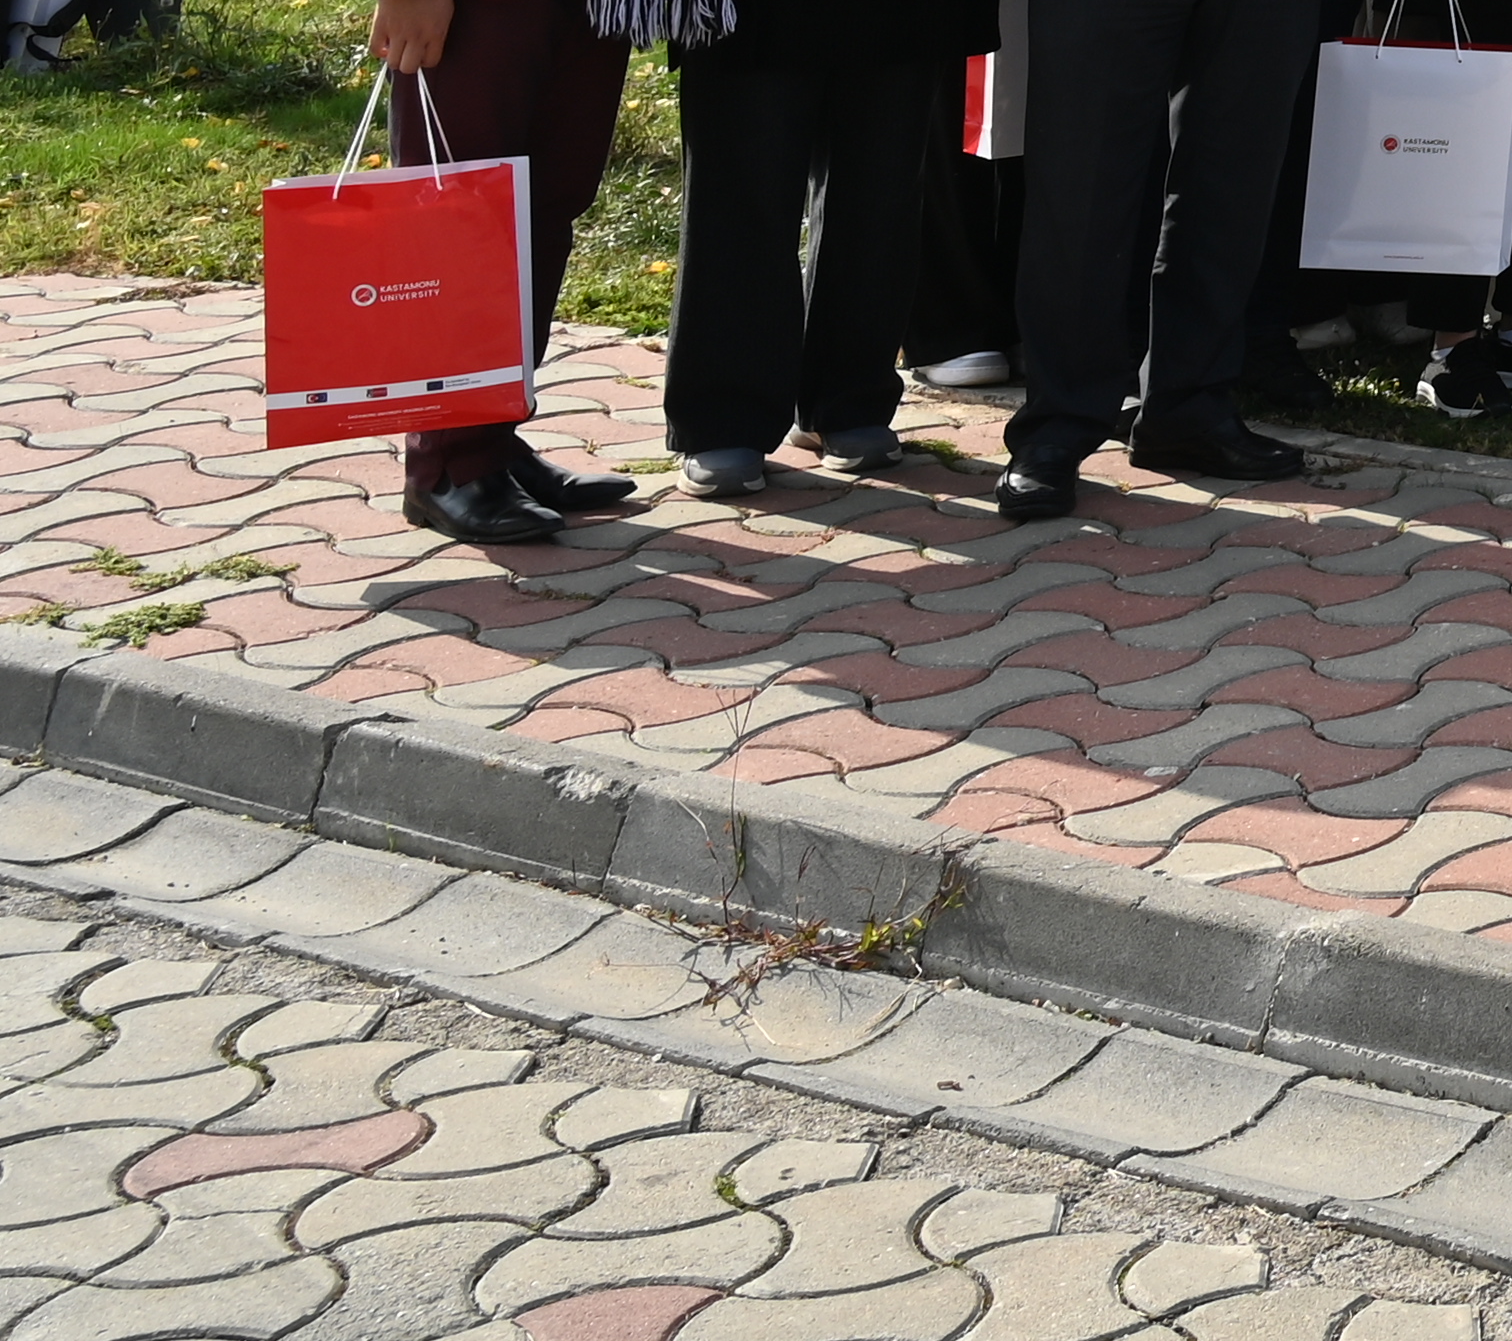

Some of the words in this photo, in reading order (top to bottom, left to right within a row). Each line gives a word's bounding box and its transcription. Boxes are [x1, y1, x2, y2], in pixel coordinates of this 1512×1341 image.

[1403, 138, 1449, 146] KASTAMONU
[1403, 146, 1448, 154] UNIVERSITY
[380, 279, 440, 293] KASTAMONU
[380, 288, 440, 303] UNIVERSITY
